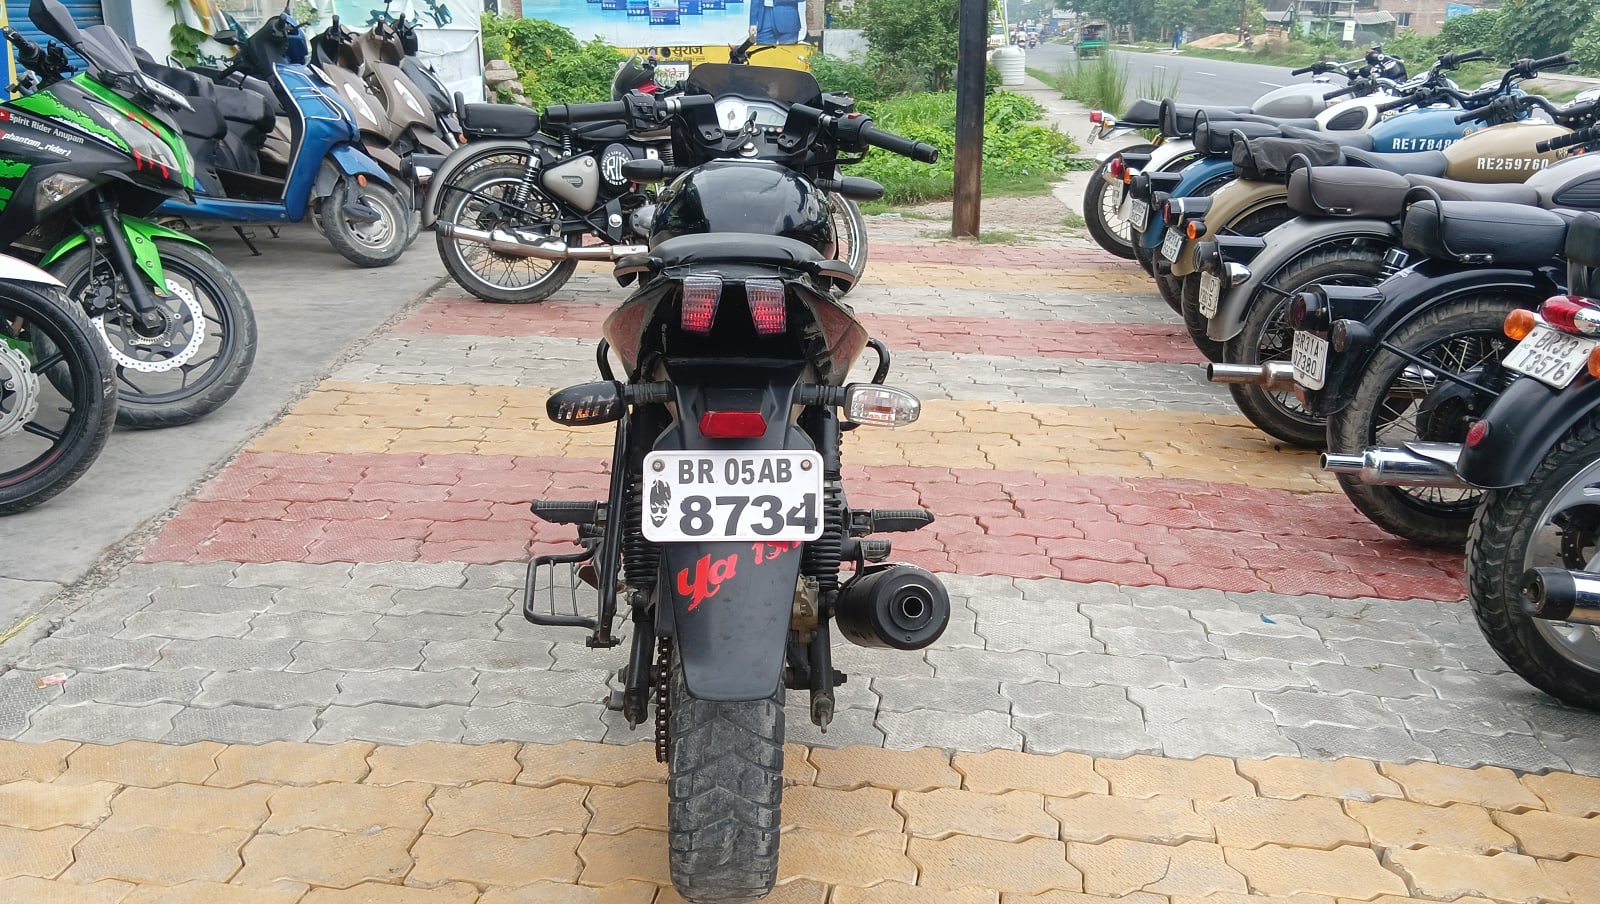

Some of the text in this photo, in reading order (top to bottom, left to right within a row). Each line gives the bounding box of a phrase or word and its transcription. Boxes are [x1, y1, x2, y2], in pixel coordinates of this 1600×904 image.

[9, 113, 84, 144] Spirit Rider Anupam
[1476, 157, 1549, 171] RE259760
[1295, 331, 1320, 358] R31A
[1534, 331, 1579, 359] BR33
[1518, 349, 1571, 381] T3576
[678, 458, 793, 485] BR 05AB
[679, 493, 819, 536] 8734
